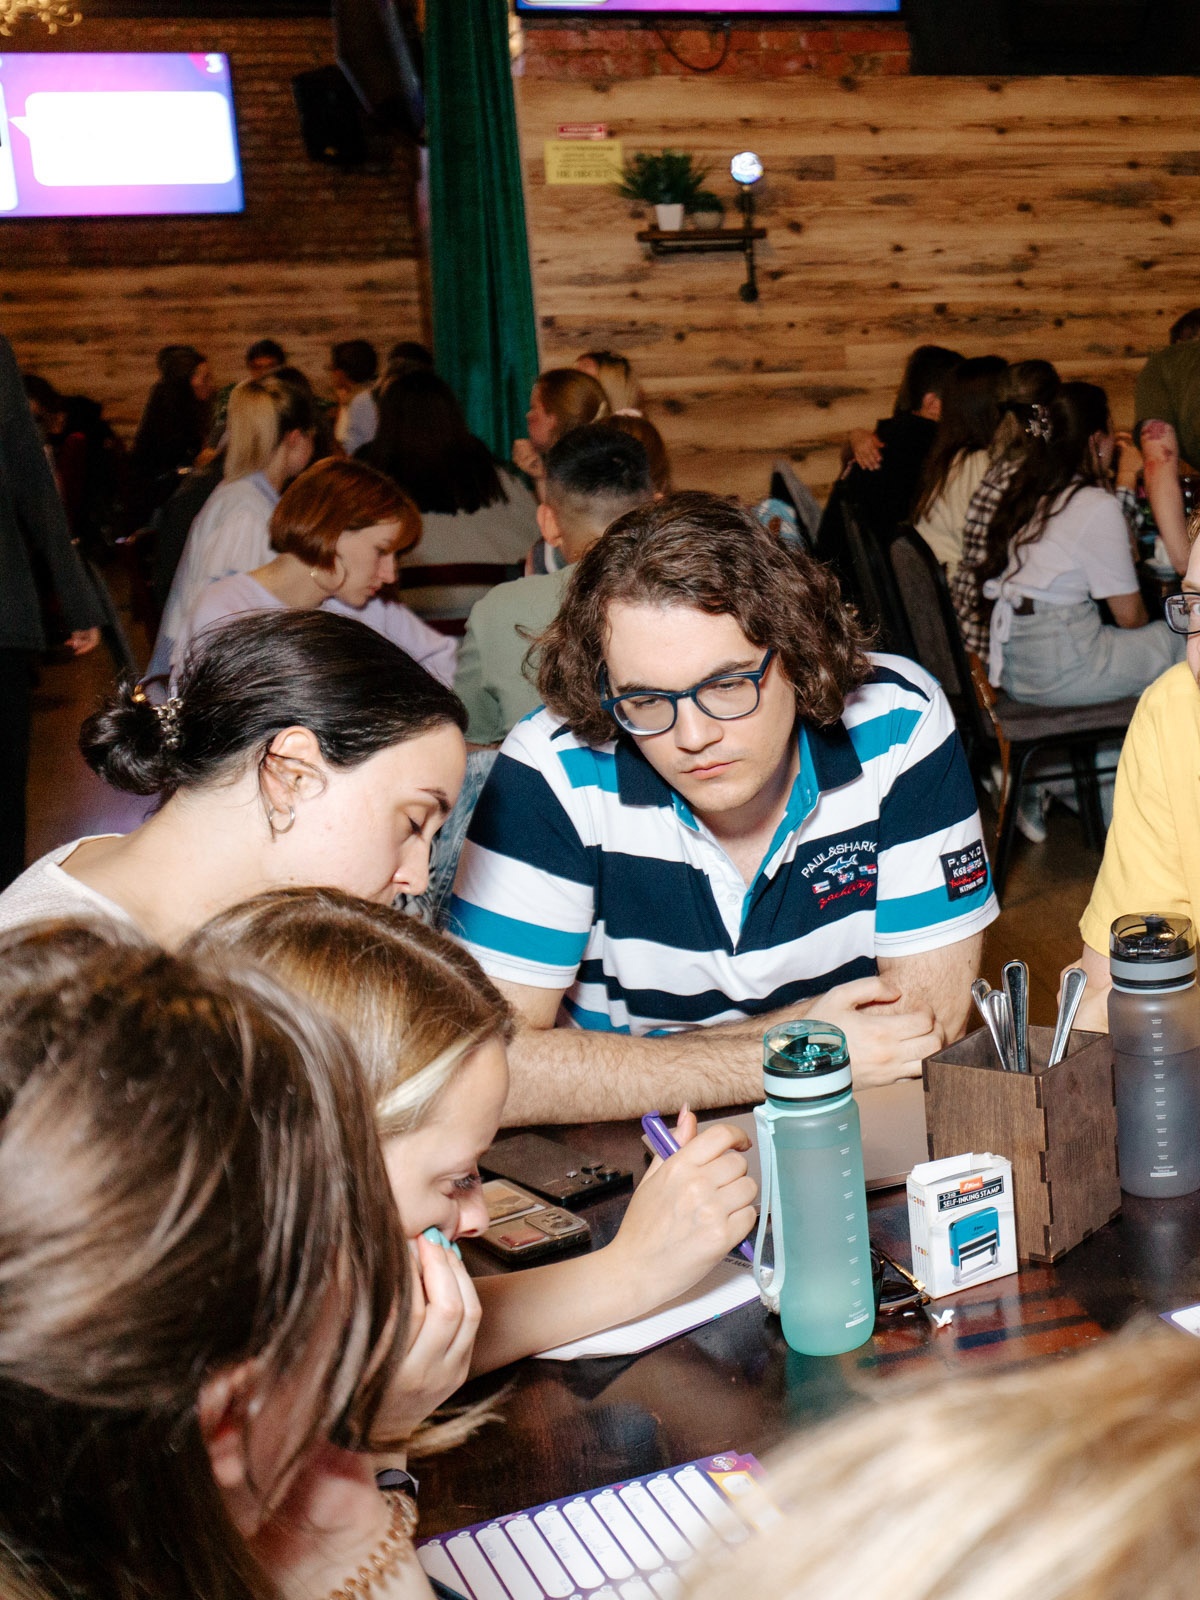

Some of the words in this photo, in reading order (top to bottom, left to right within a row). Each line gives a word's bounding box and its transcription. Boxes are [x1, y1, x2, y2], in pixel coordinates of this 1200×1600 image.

[800, 841, 878, 879] PAUL&SHARK
[943, 1193, 980, 1208] SELF-INKING
[980, 1185, 1000, 1199] STAMP
